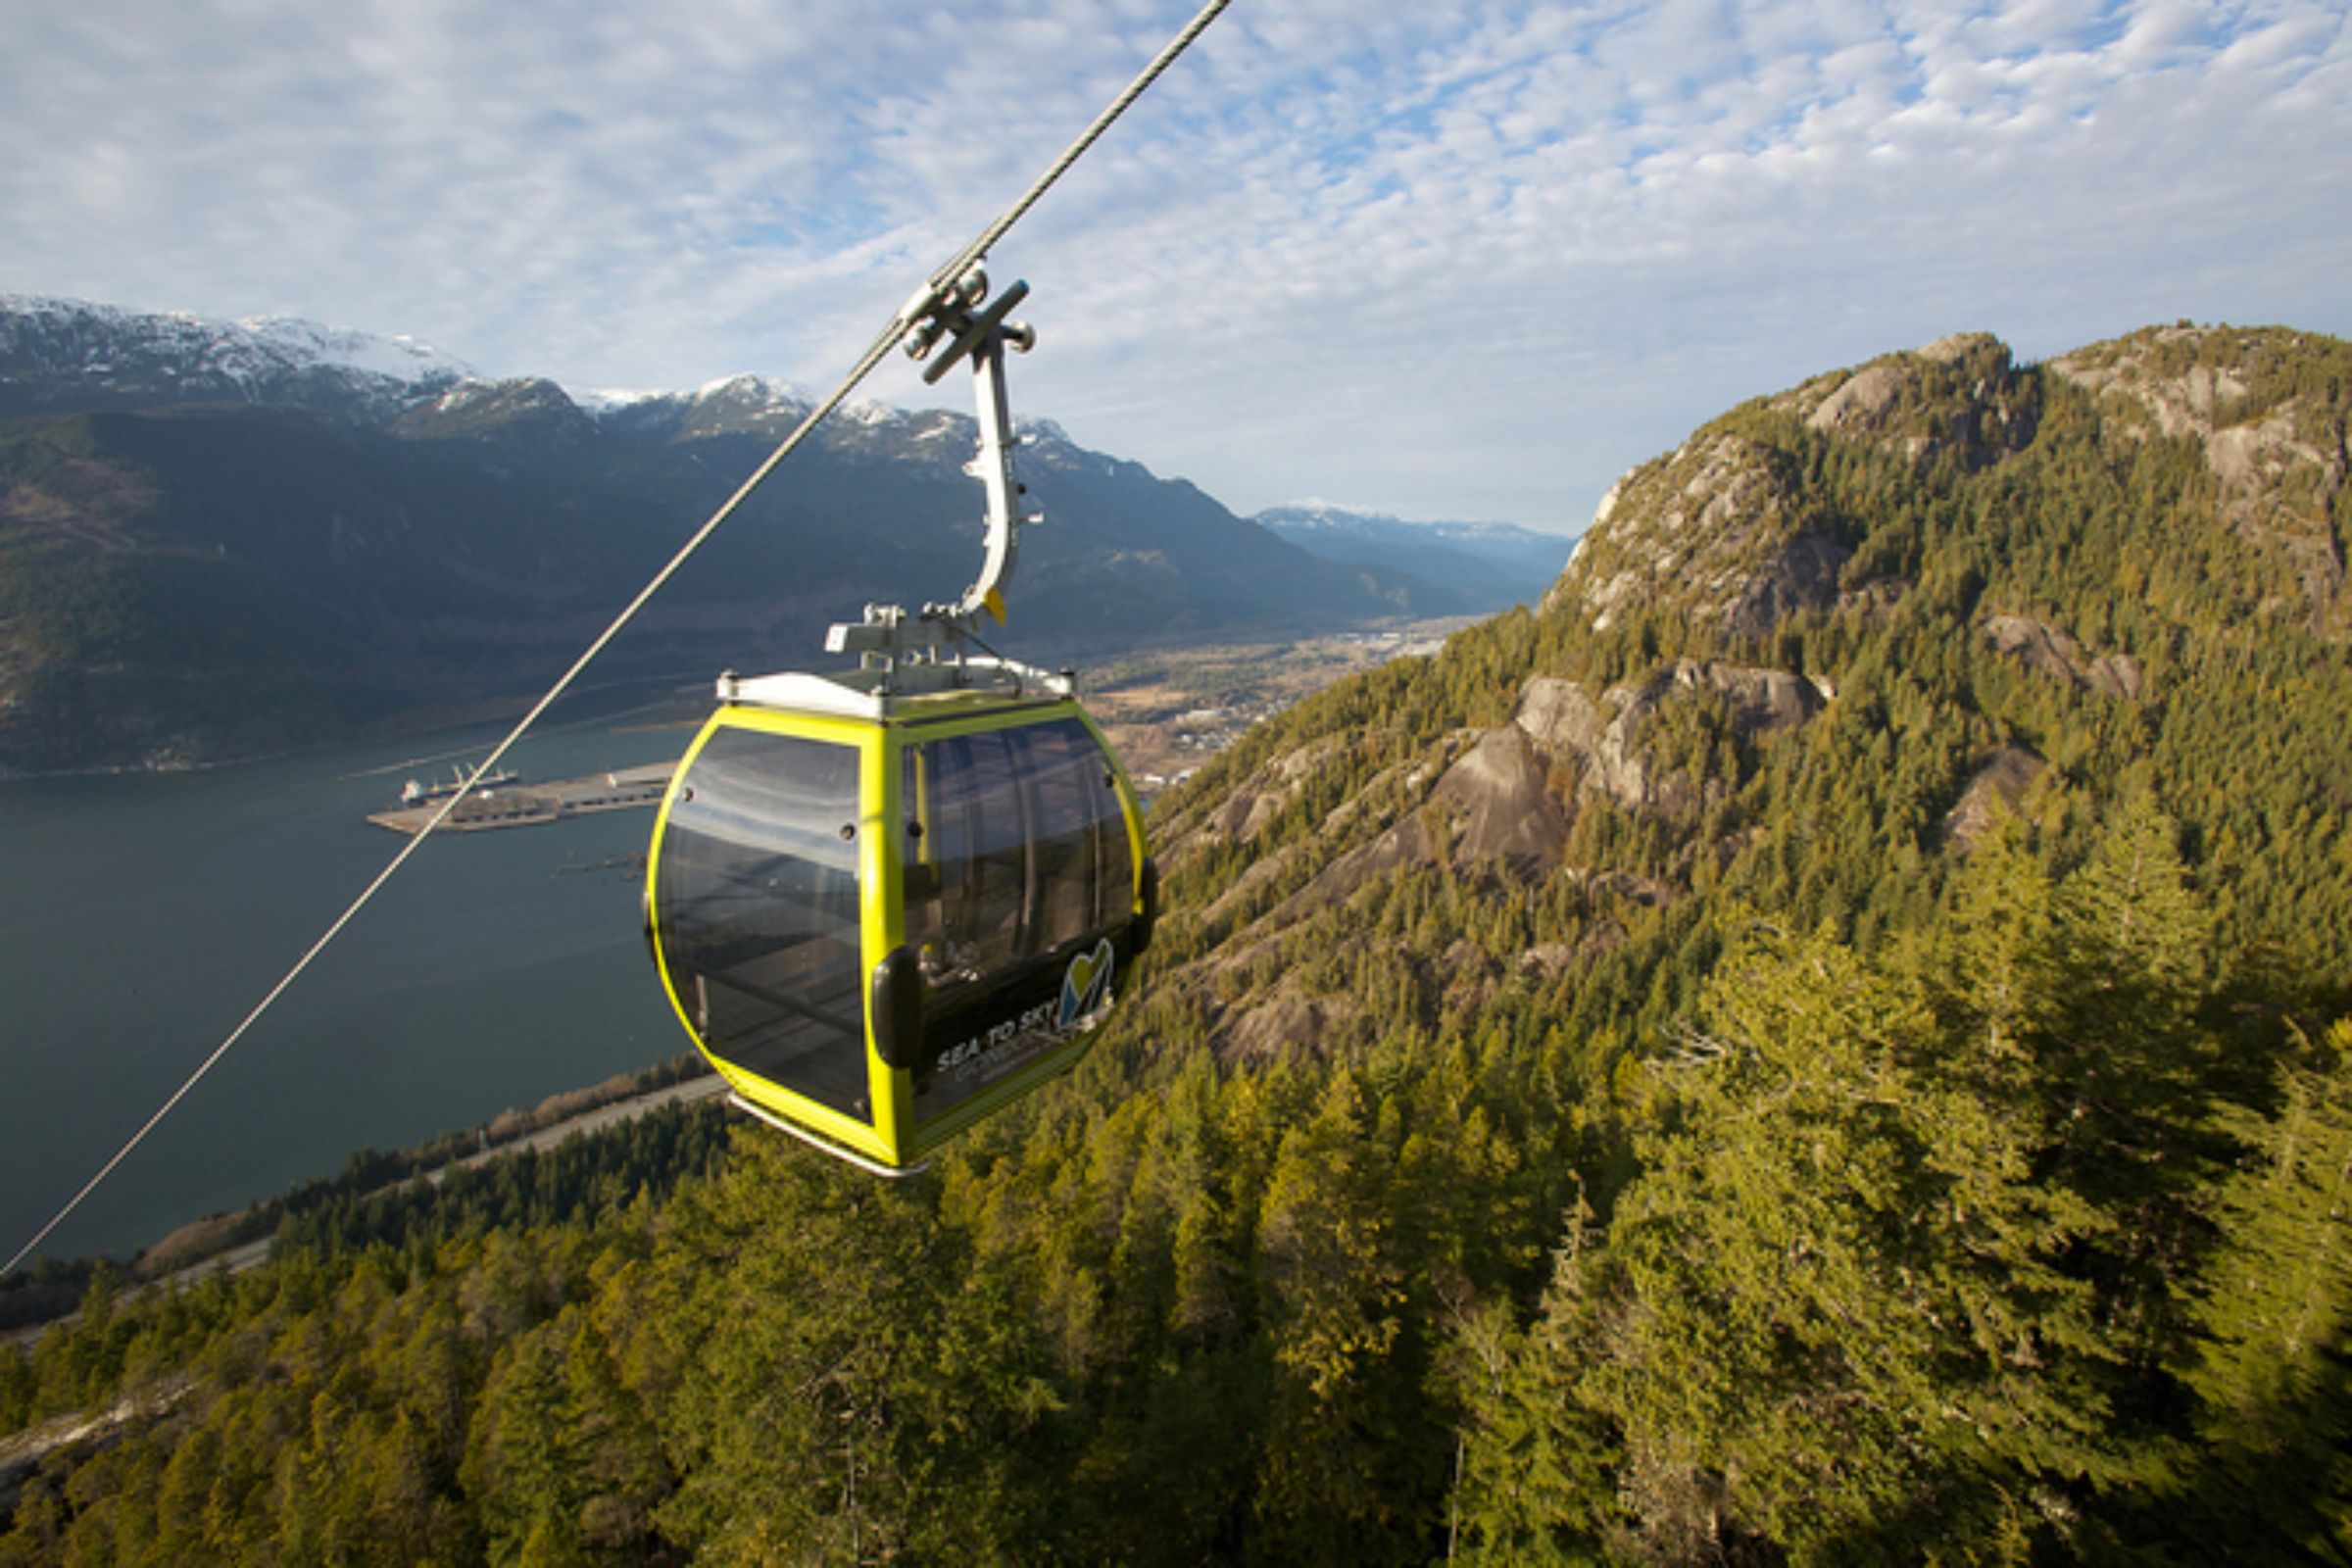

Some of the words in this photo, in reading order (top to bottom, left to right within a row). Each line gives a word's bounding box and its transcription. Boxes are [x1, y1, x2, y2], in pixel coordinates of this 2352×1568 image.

[937, 1037, 980, 1072] SEA
[987, 1019, 1015, 1046] TO
[1019, 998, 1058, 1030] SKY
